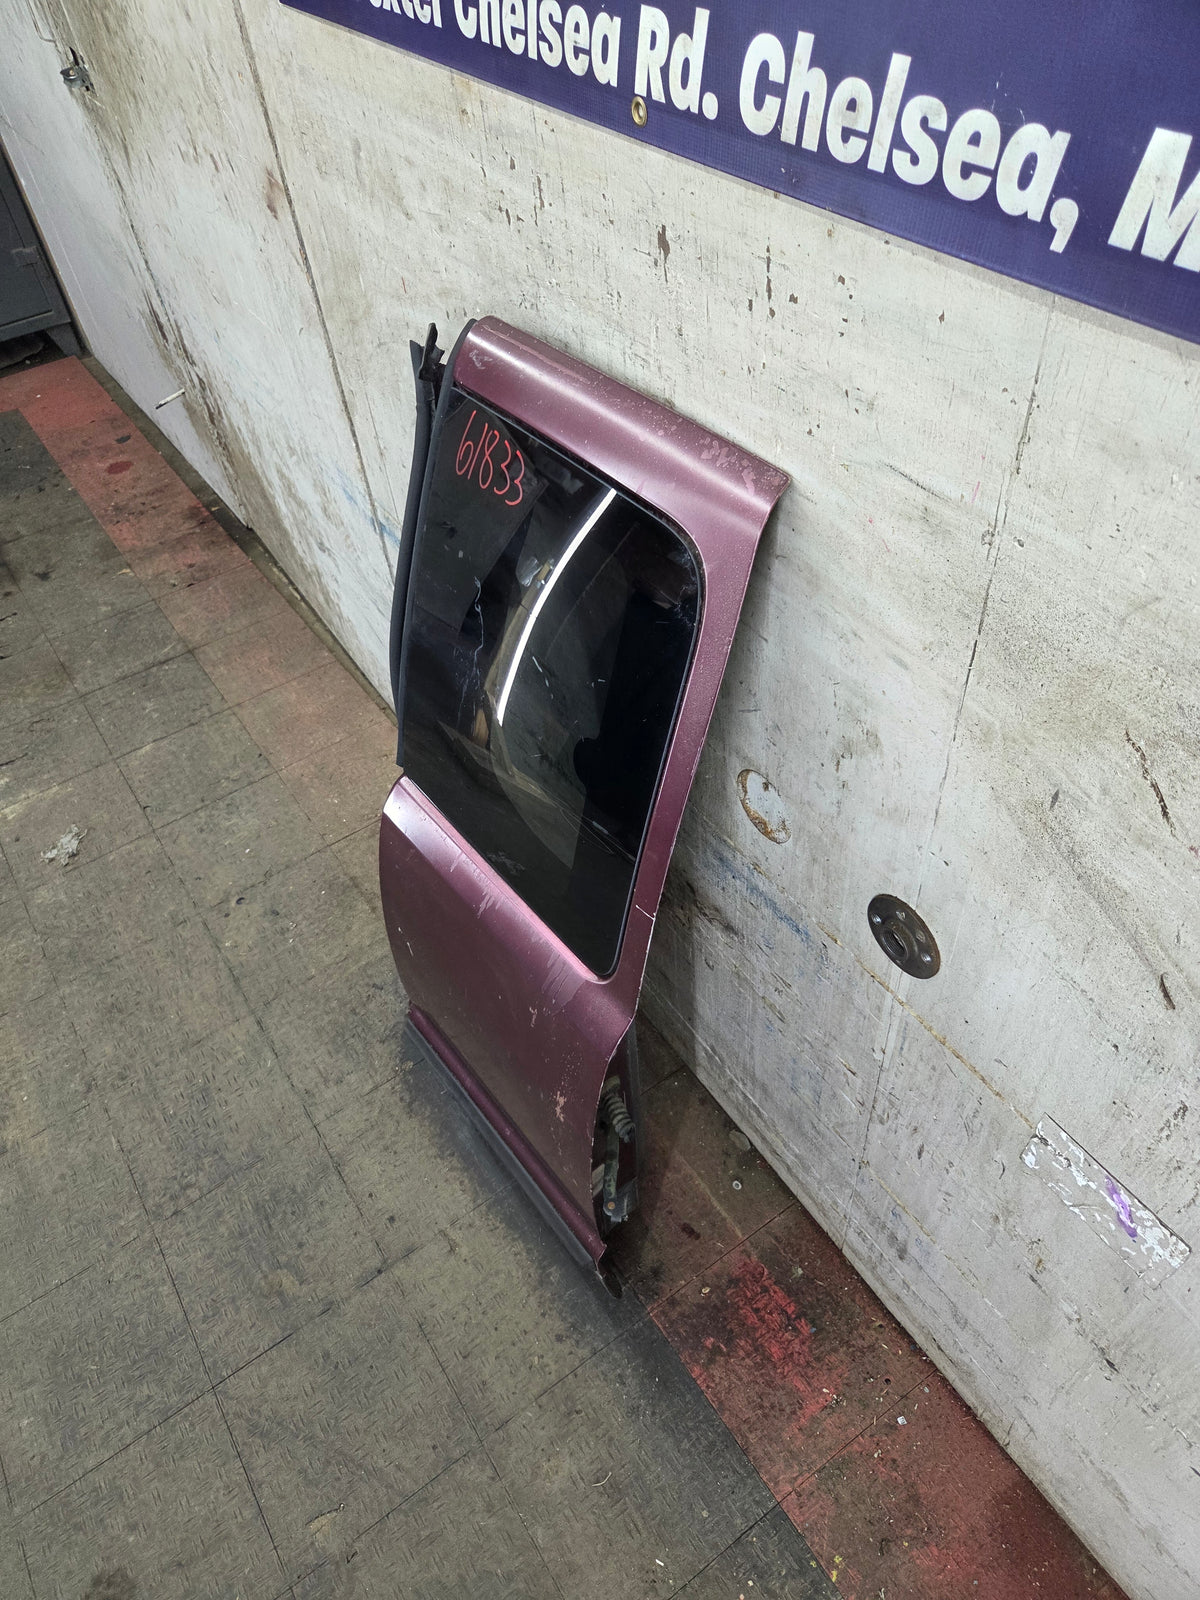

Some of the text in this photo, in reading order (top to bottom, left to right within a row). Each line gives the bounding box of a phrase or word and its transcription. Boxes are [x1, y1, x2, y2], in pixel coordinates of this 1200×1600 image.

[453, 0, 622, 88] Chelsea
[634, 4, 719, 120] Rd.
[739, 30, 1079, 254] Chelsea,
[455, 410, 525, 506] 61833
